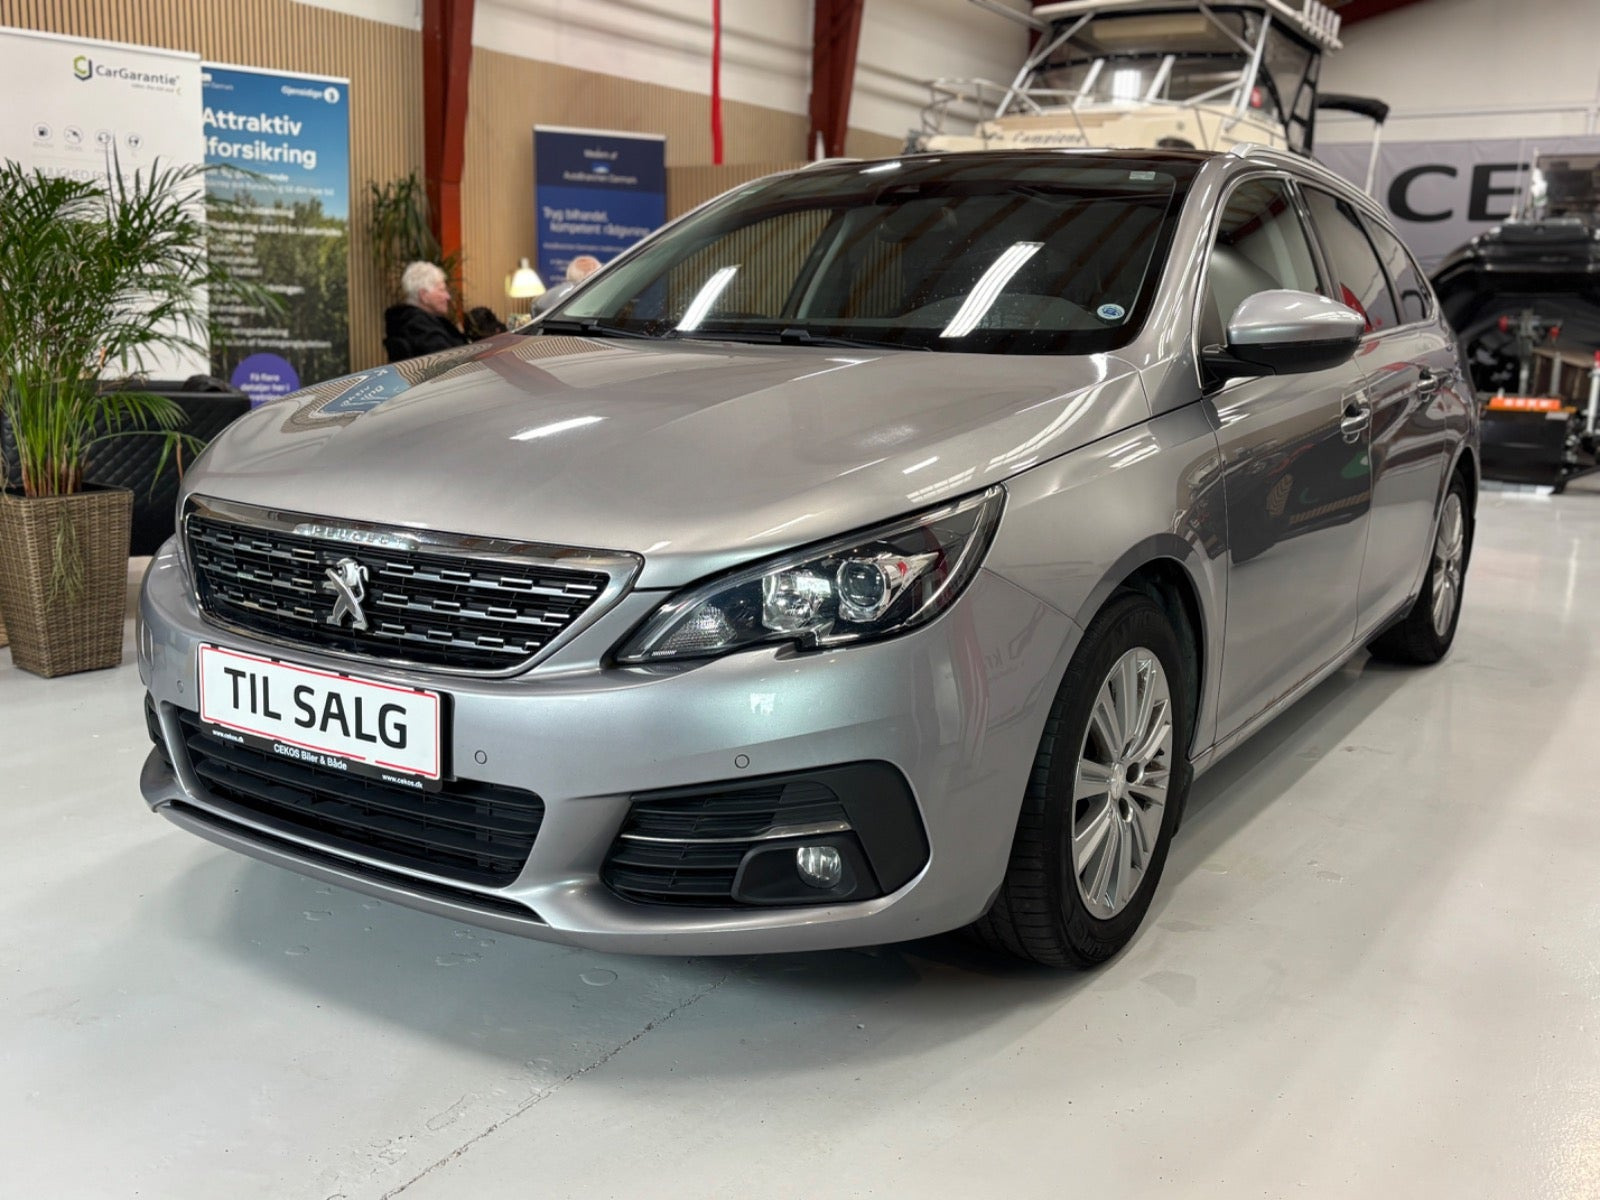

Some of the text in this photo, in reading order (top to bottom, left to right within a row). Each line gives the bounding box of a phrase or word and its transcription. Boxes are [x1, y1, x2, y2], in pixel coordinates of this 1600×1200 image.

[203, 107, 302, 136] Attraktiv
[224, 666, 408, 750] TIL SALG
[212, 729, 244, 743] www.cekos.dk
[273, 743, 348, 771] CEKOS Biler & Både
[381, 773, 424, 790] www.cekos.dk
